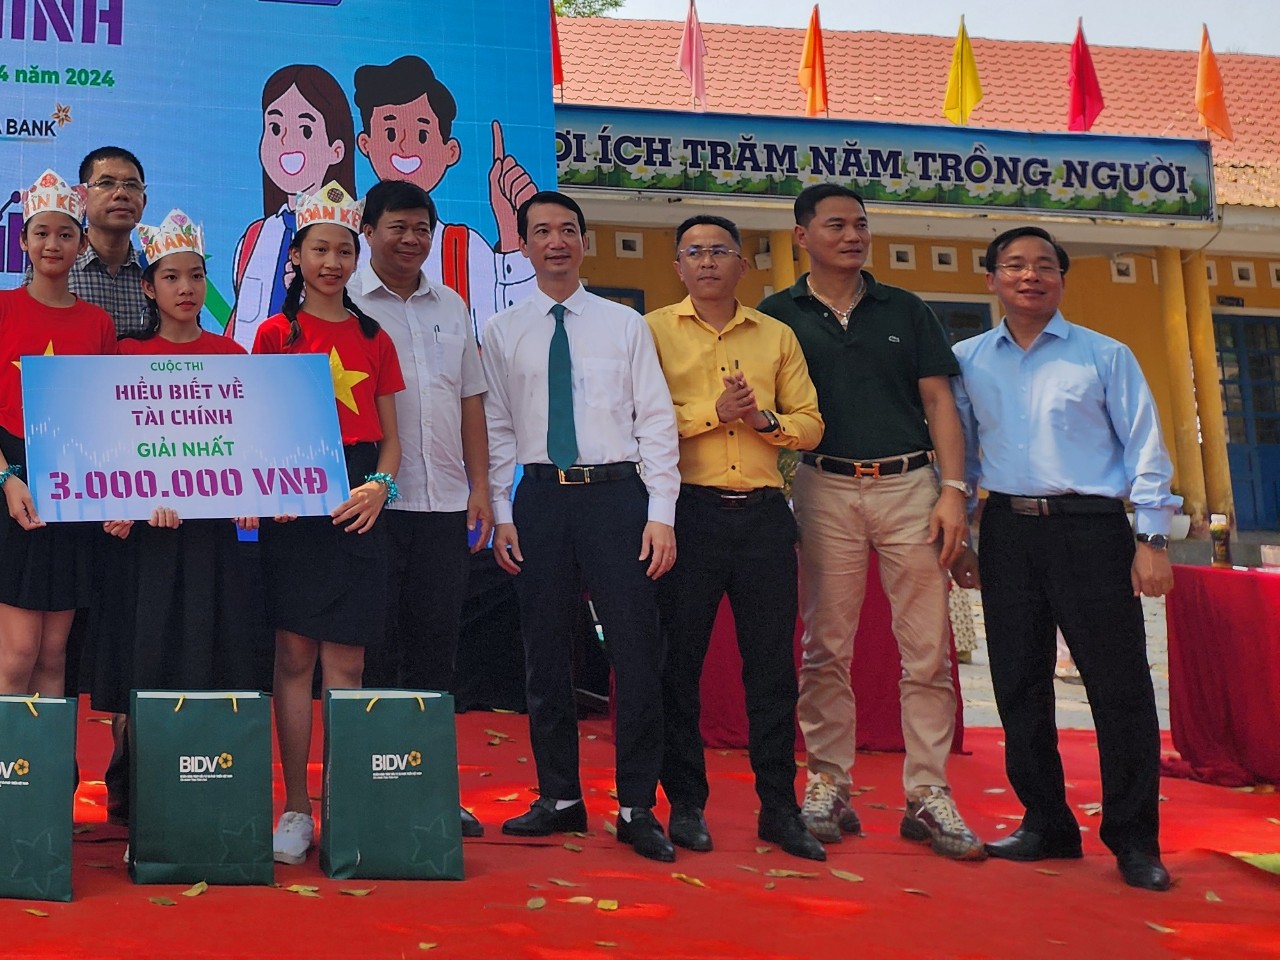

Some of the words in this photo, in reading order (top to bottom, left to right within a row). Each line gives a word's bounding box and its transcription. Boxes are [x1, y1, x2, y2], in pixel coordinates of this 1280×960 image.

[15, 62, 60, 85] năm
[65, 67, 115, 87] 2024
[6, 118, 57, 137] BANK
[597, 124, 672, 168] ÍCH
[683, 134, 799, 174] TRĂM
[808, 140, 903, 180] NĂM
[913, 143, 1052, 188] TRỒNG
[1062, 156, 1189, 194] NGƯỜI
[150, 359, 182, 374] CUỘC
[184, 361, 204, 372] THI
[115, 375, 163, 401] HIỂU
[168, 376, 214, 400] BIẾT
[217, 376, 245, 400] VỀ
[131, 405, 165, 426] TÀI
[170, 405, 233, 425] CHÍNH
[137, 436, 177, 458] GIẢI
[182, 434, 235, 457] NHẤT
[48, 467, 244, 500] 3.000.000
[251, 466, 329, 496] VNĐ
[179, 755, 219, 773] BIDV
[371, 753, 409, 771] BIDV
